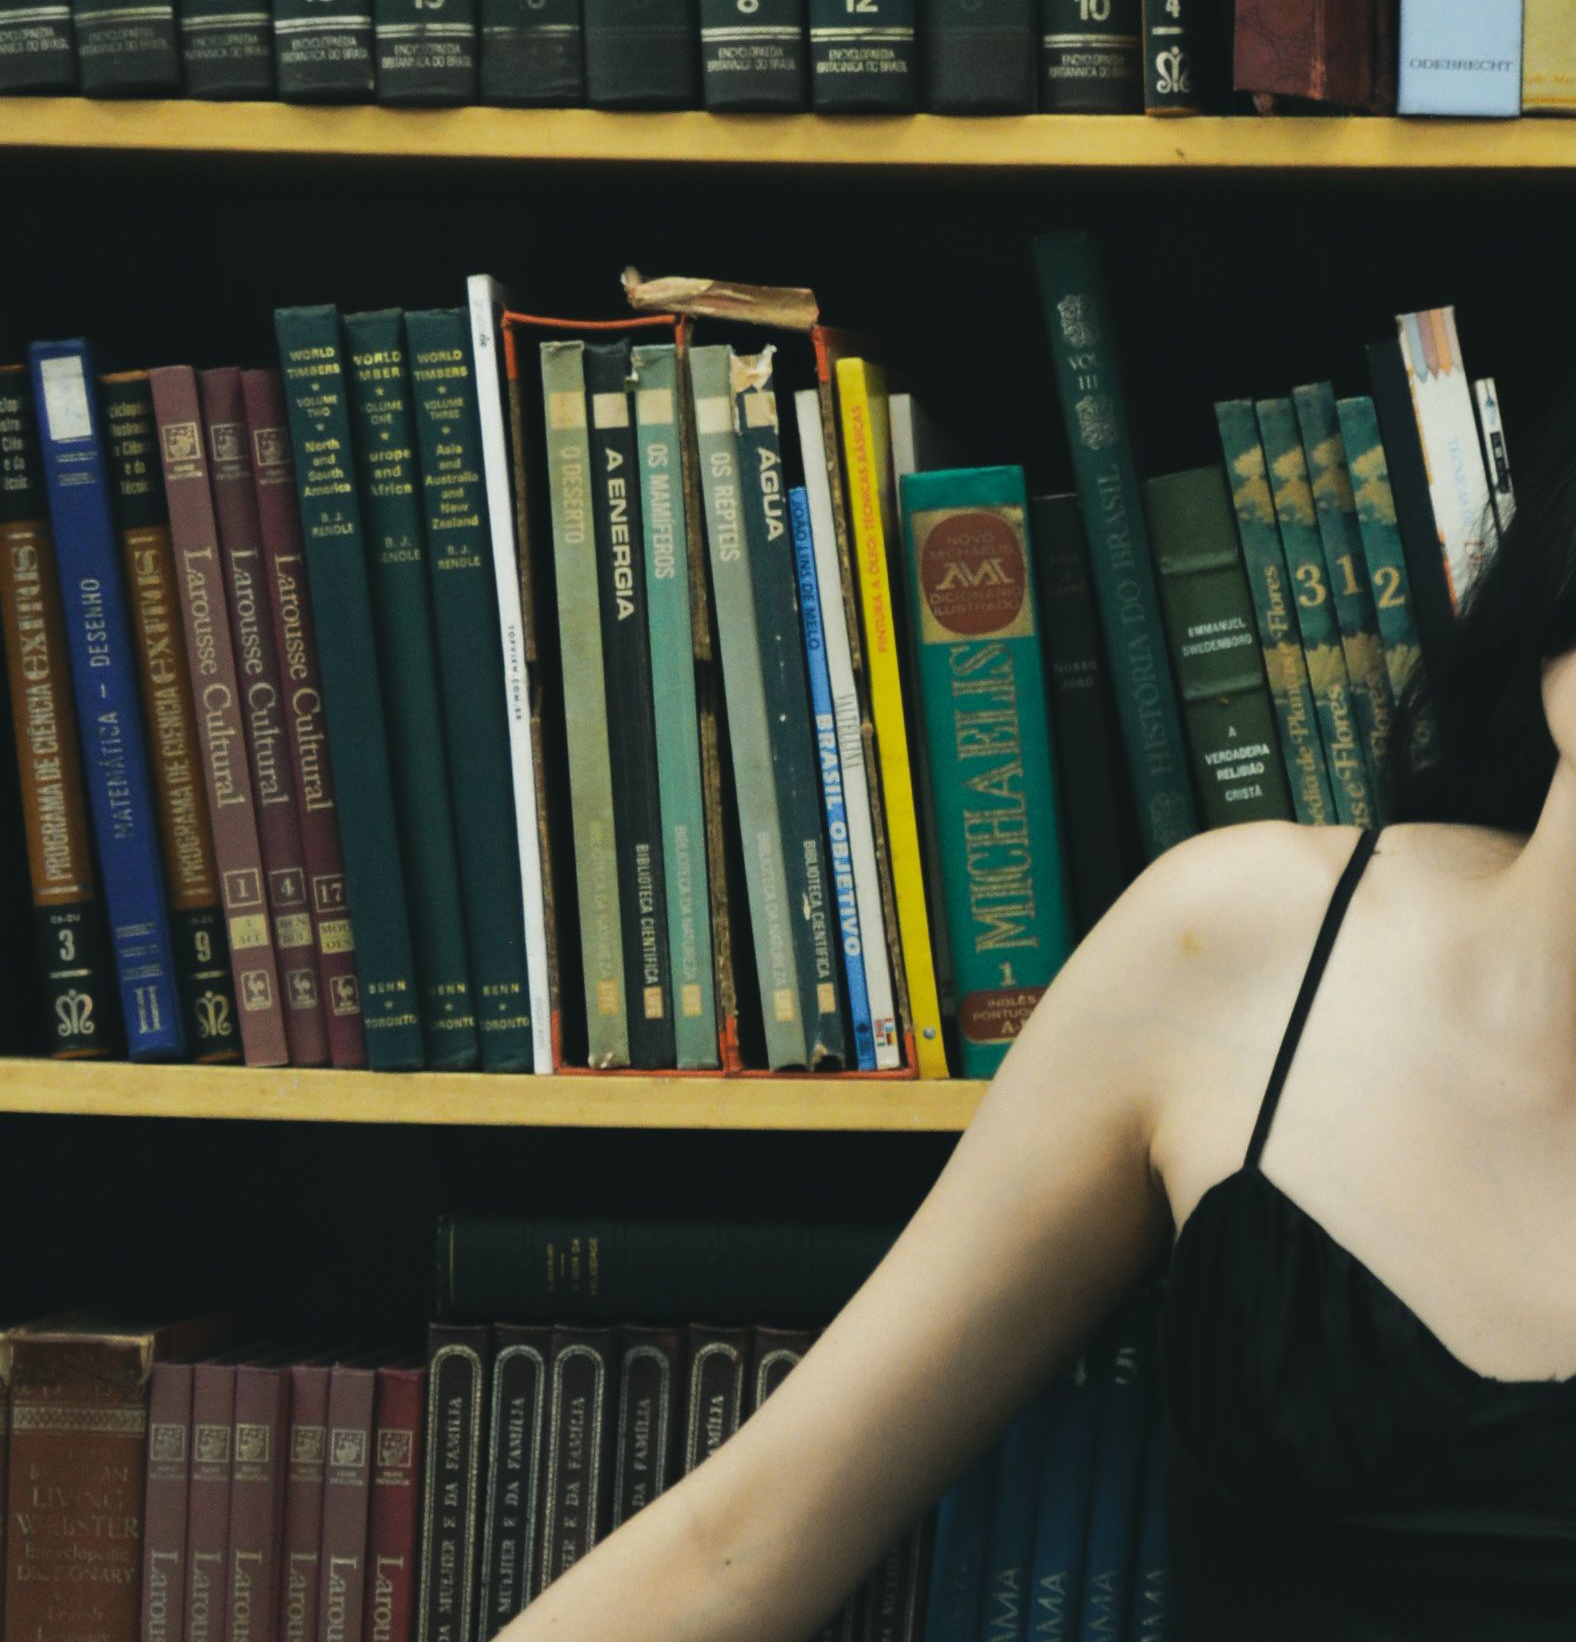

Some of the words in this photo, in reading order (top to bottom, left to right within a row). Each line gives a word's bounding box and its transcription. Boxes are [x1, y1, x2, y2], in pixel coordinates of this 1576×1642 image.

[1409, 56, 1514, 73] ODEBRECHT
[287, 363, 342, 379] TIMBERS
[289, 346, 335, 362] WORLD
[414, 365, 468, 381] TIMBERS
[417, 349, 463, 364] WORLD
[305, 437, 340, 453] North
[312, 453, 336, 467] and
[605, 448, 623, 471] A
[648, 444, 668, 467] OS
[308, 467, 344, 482] South
[711, 453, 731, 478] OS
[303, 482, 352, 497] America
[561, 463, 584, 545] DESERTO
[758, 447, 784, 542] ÁGUA
[1098, 464, 1142, 576] BRASIL
[609, 478, 634, 622] ENERGIA
[1295, 566, 1326, 608] 3
[1338, 554, 1363, 596] 1
[1374, 566, 1406, 608] 2
[80, 578, 111, 668] DESENHO
[1121, 580, 1147, 628] DO
[1265, 565, 1289, 641] Flores
[183, 547, 217, 677] Larousse
[203, 684, 245, 809] Cultural
[230, 549, 263, 676] Larousse
[248, 682, 289, 807] Cultural
[274, 554, 307, 680] Larousse
[292, 688, 334, 813] Cultural
[1328, 683, 1359, 772] Flores
[32, 749, 62, 782] DE
[97, 710, 135, 840] MATEMÁTICA
[947, 641, 1039, 956] MICHAELIS
[32, 783, 68, 881] PROGRAMA
[816, 713, 843, 809] BRASIL
[830, 821, 861, 957] OBJETIVO
[238, 879, 248, 898] 1
[280, 877, 295, 897] 4
[320, 883, 343, 904] 17
[635, 842, 654, 913] BIBLIOTECA
[58, 929, 75, 962] 3
[1000, 963, 1017, 987] 1
[1112, 1346, 1137, 1386] 5
[444, 1482, 459, 1506] DA
